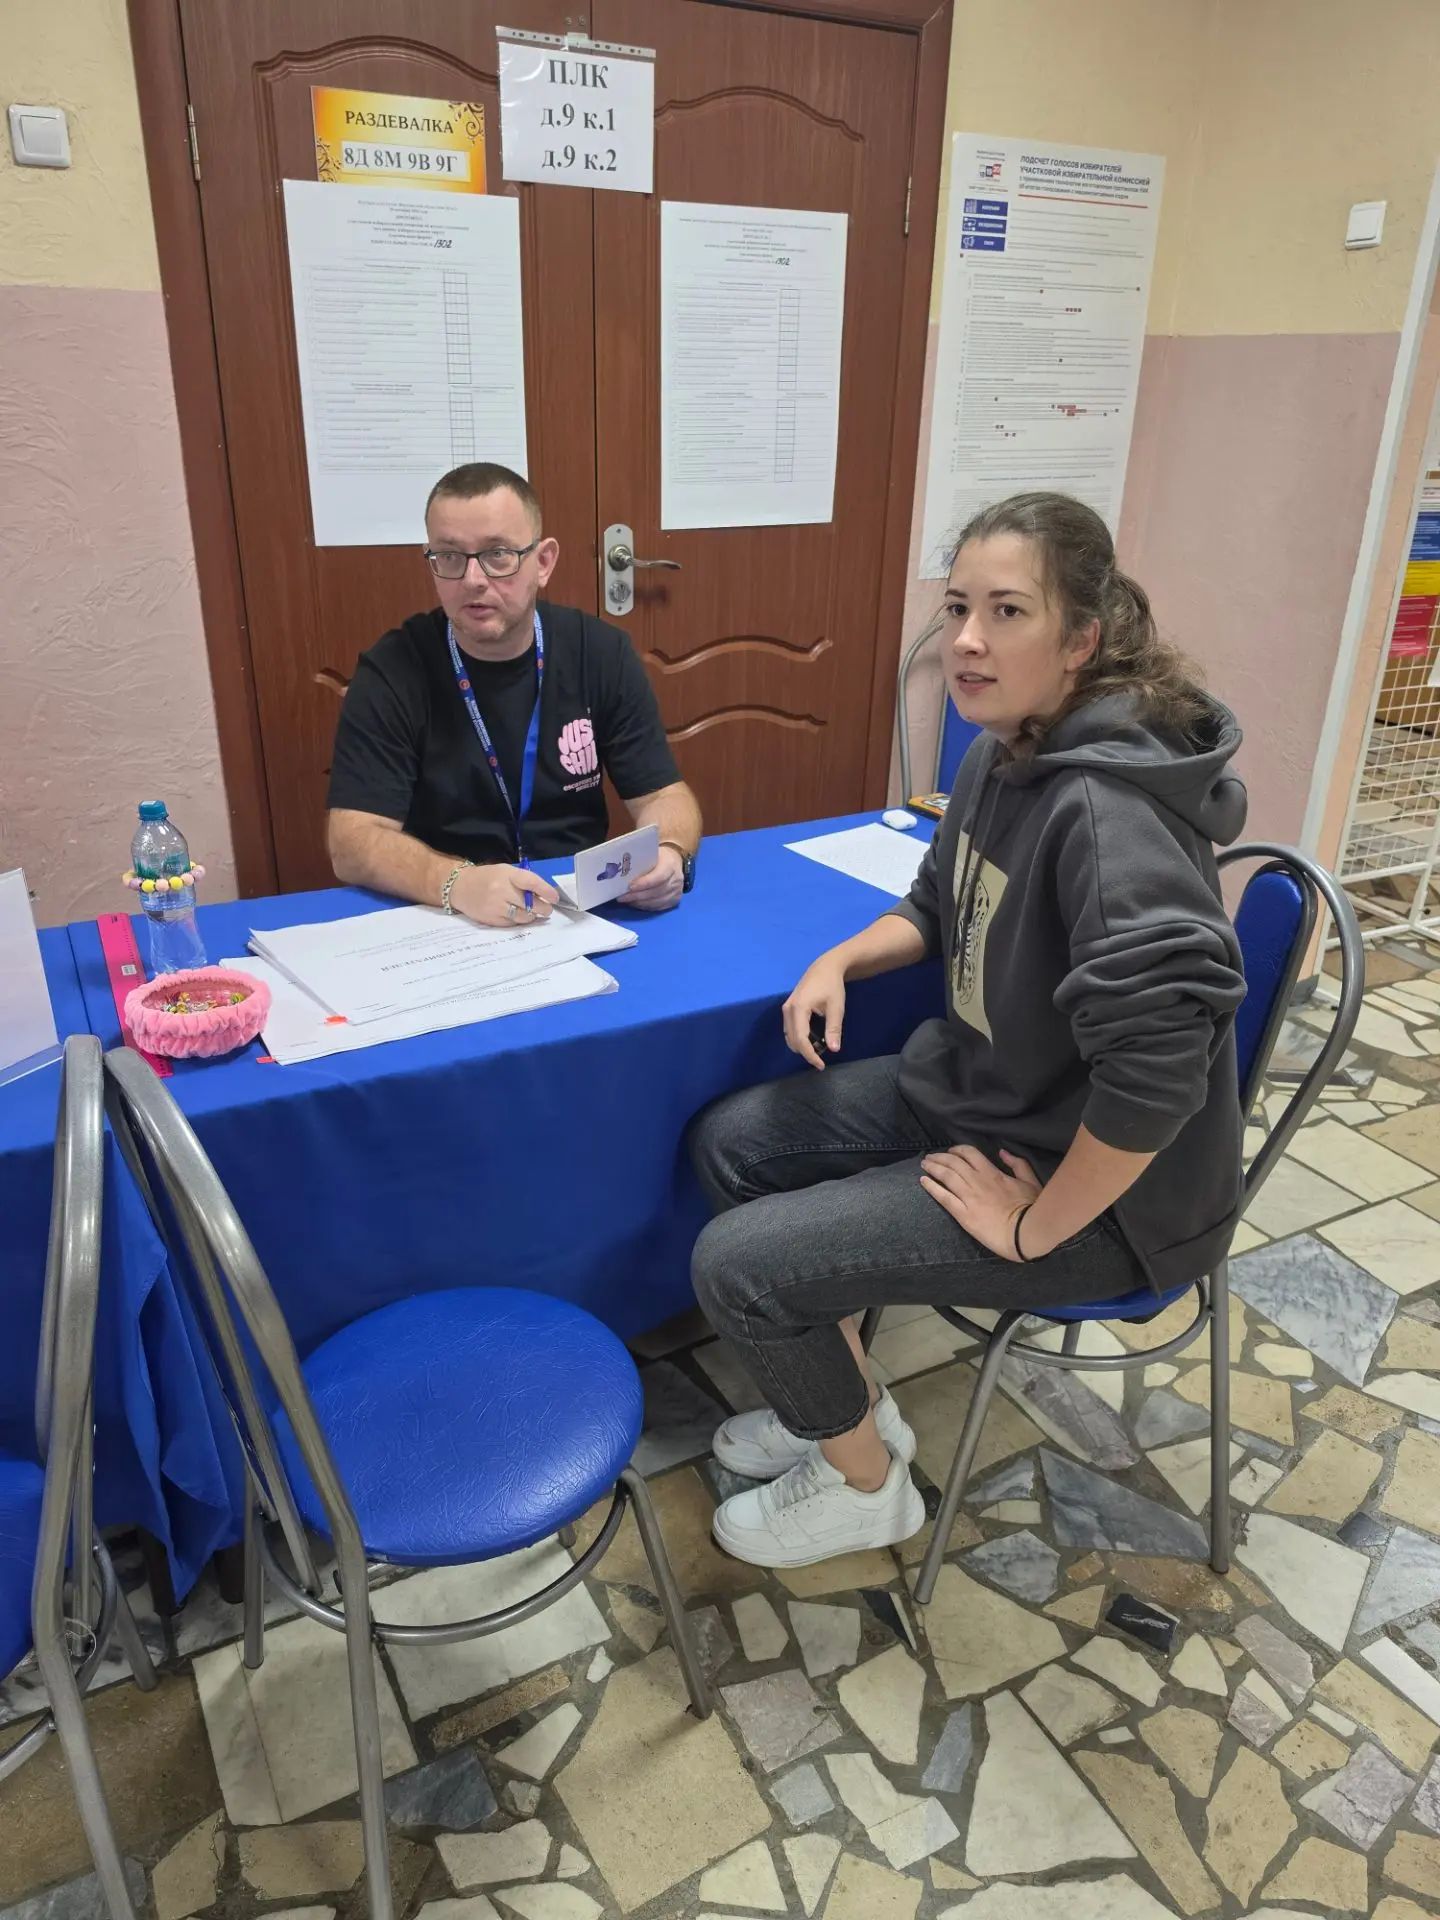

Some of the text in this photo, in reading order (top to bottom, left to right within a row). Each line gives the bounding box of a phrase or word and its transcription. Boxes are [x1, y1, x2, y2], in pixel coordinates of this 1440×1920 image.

[548, 58, 609, 89] ПЛК
[344, 110, 454, 134] РАЗДЕВАЛКА
[540, 103, 616, 132] д.9 к.1
[344, 147, 457, 172] 8Д 8М 9В 9Г
[541, 145, 617, 172] д.9 к.2
[1020, 155, 1122, 173] ПОДСЧЕТ ГОЛОСОВ ИЗБИРАТЕЛЕЙ
[1020, 166, 1061, 177] УЧАСТКОВОЙ
[1062, 169, 1113, 182] ИЗБИРАТЕЛЬНОЙ
[1113, 174, 1150, 185] КОМИССИЕЙ
[434, 239, 452, 249] 1302
[558, 718, 593, 755] JUS
